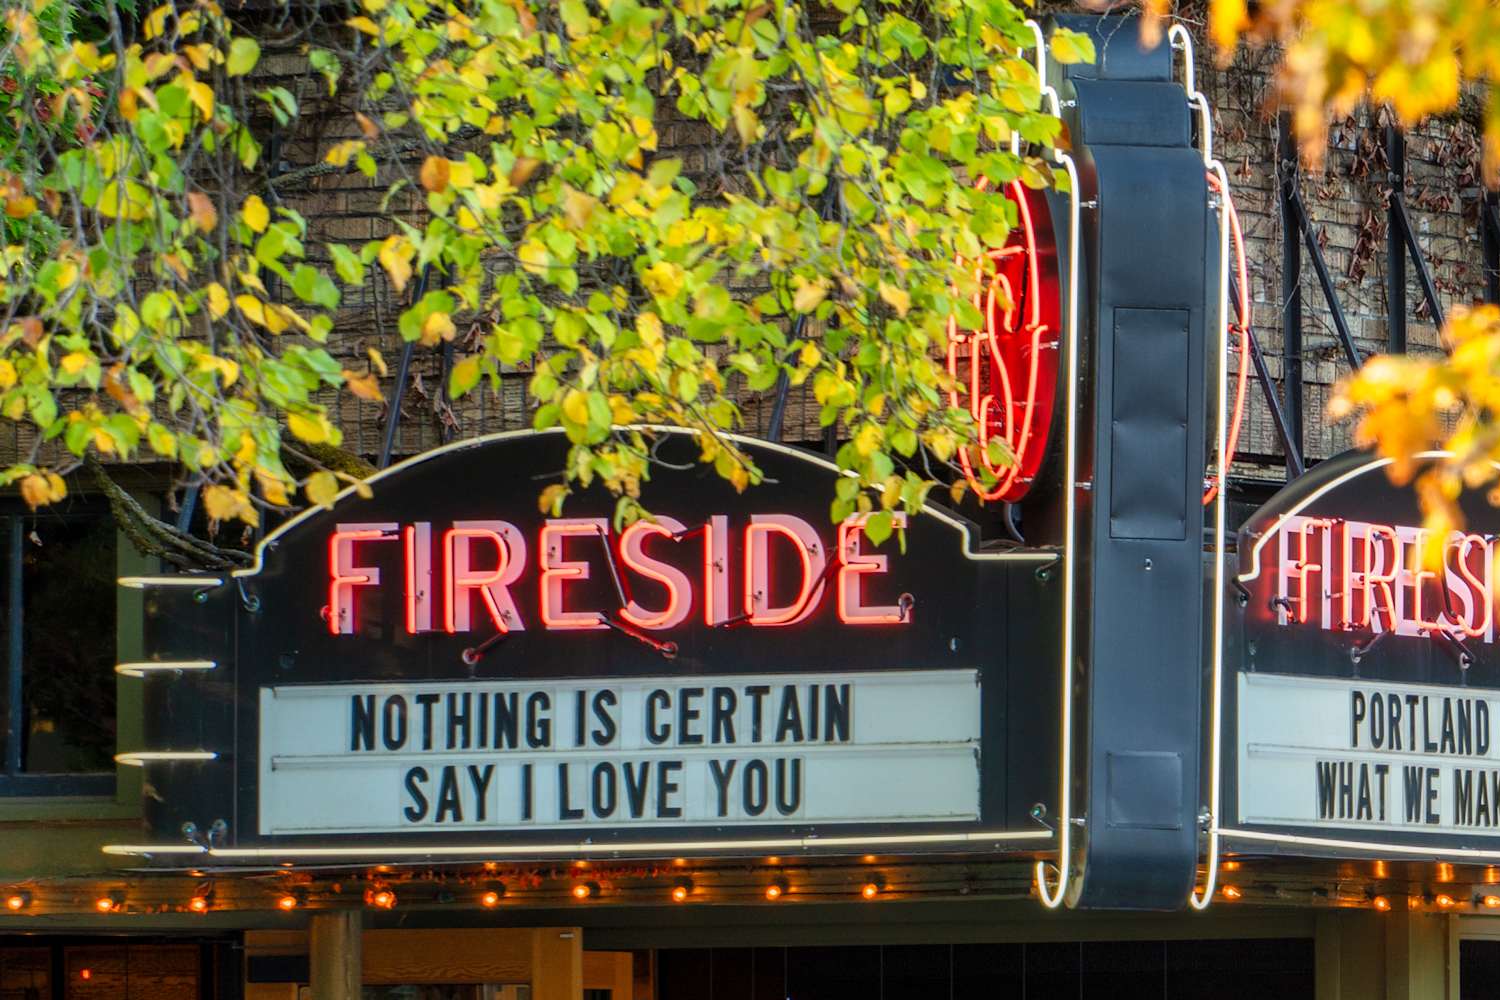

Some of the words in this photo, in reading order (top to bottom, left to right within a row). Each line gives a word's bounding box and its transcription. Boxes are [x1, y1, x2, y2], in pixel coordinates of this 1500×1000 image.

[328, 512, 911, 634] FIRESIDE
[351, 690, 551, 751] NOTHING
[577, 689, 618, 744] IS
[645, 683, 852, 745] CERTAIN
[1352, 690, 1490, 756] PORTLAND
[404, 764, 495, 822] SAY
[521, 763, 533, 820] I
[558, 760, 683, 820] LOVE
[709, 758, 802, 817] YOU
[1317, 761, 1389, 821] WHAT
[1403, 765, 1440, 824] WE
